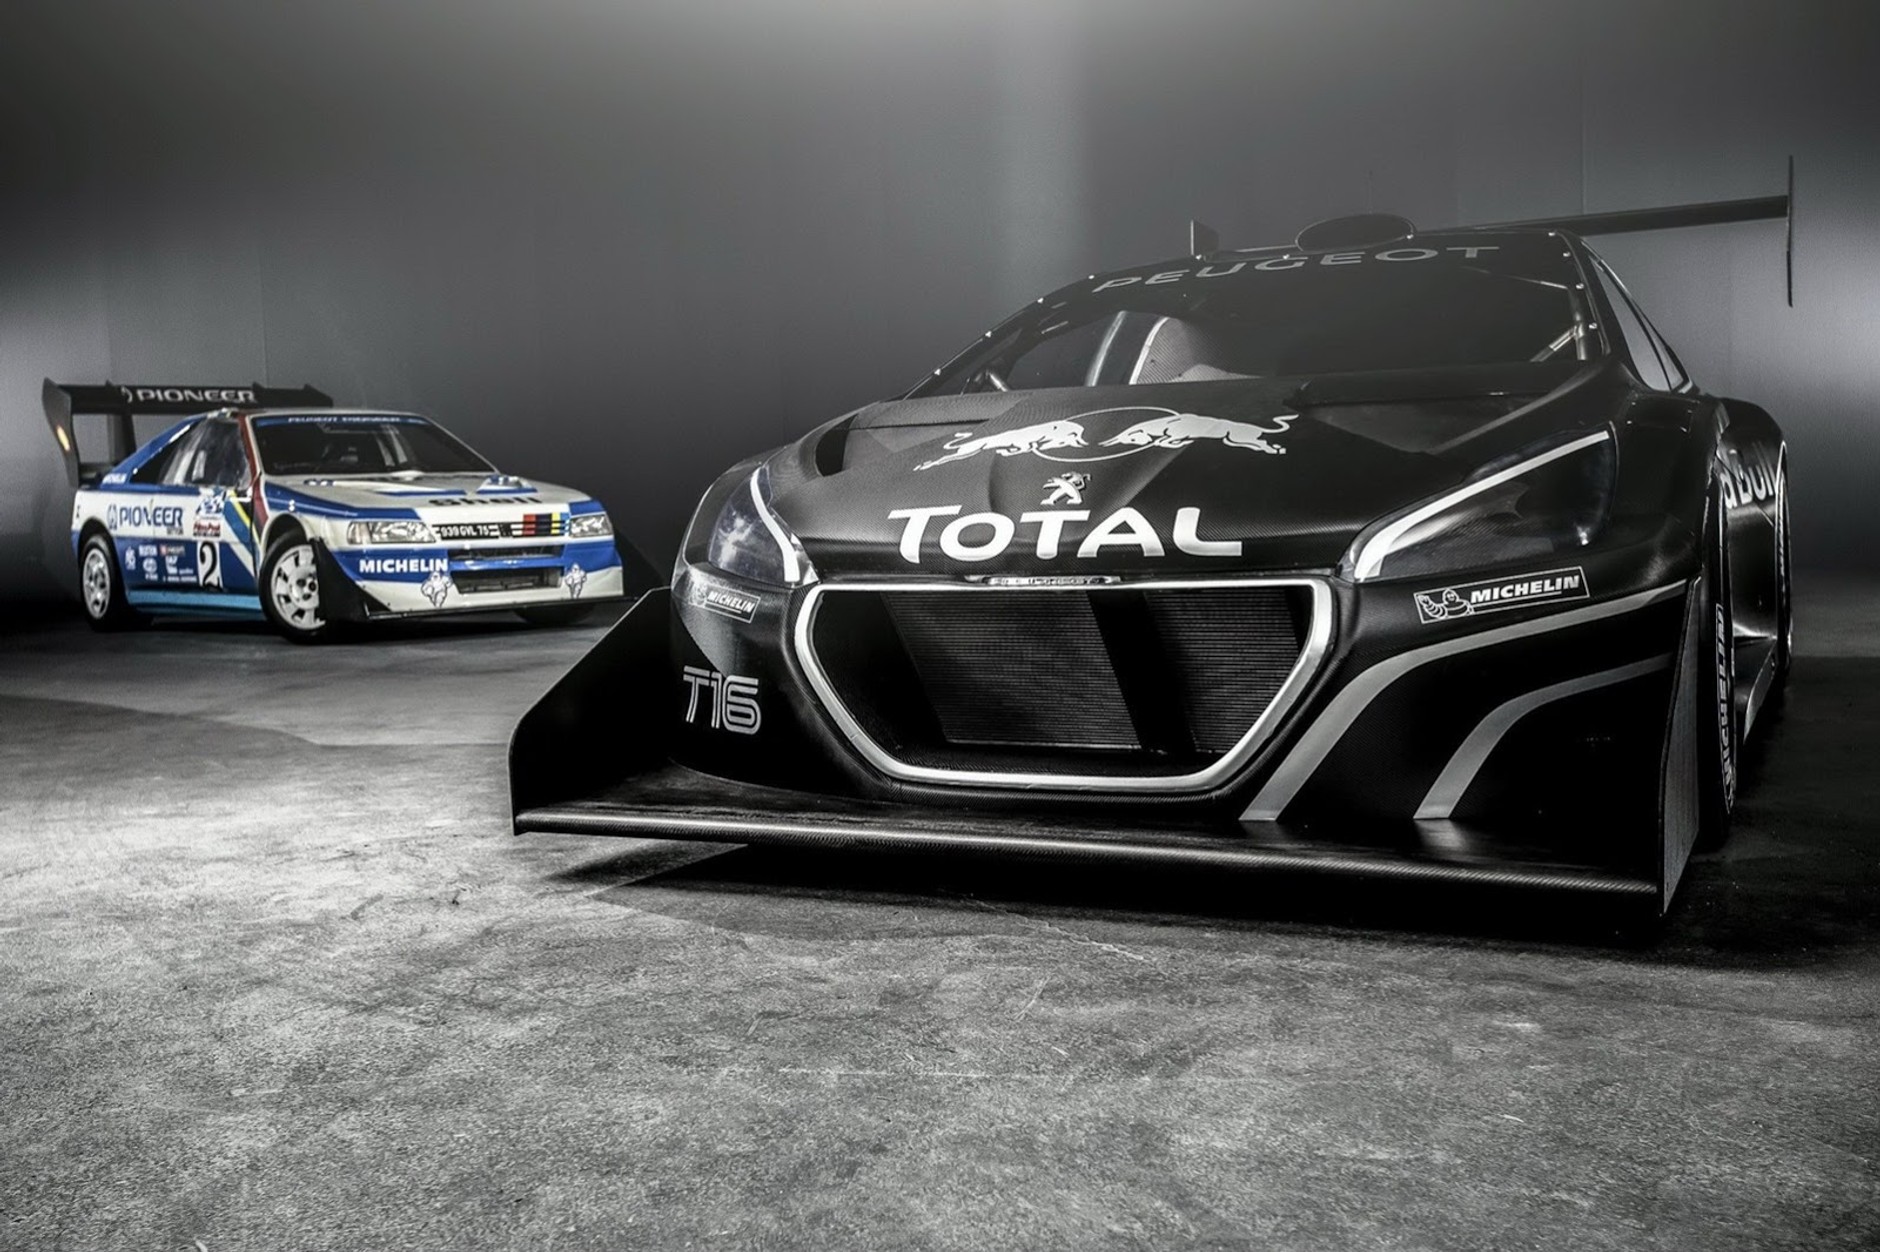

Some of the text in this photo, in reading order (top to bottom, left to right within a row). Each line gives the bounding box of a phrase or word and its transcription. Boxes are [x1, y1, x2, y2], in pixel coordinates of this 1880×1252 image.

[1092, 246, 1500, 293] PEUGEOT
[136, 388, 257, 402] PIONEER
[119, 505, 184, 528] PIONEER
[887, 504, 1243, 564] TOTAL
[199, 540, 220, 590] 2
[359, 558, 449, 573] MICHELIN
[707, 590, 756, 613] MICHELIN
[1470, 574, 1580, 604] MICHELIN
[683, 665, 762, 736] T16
